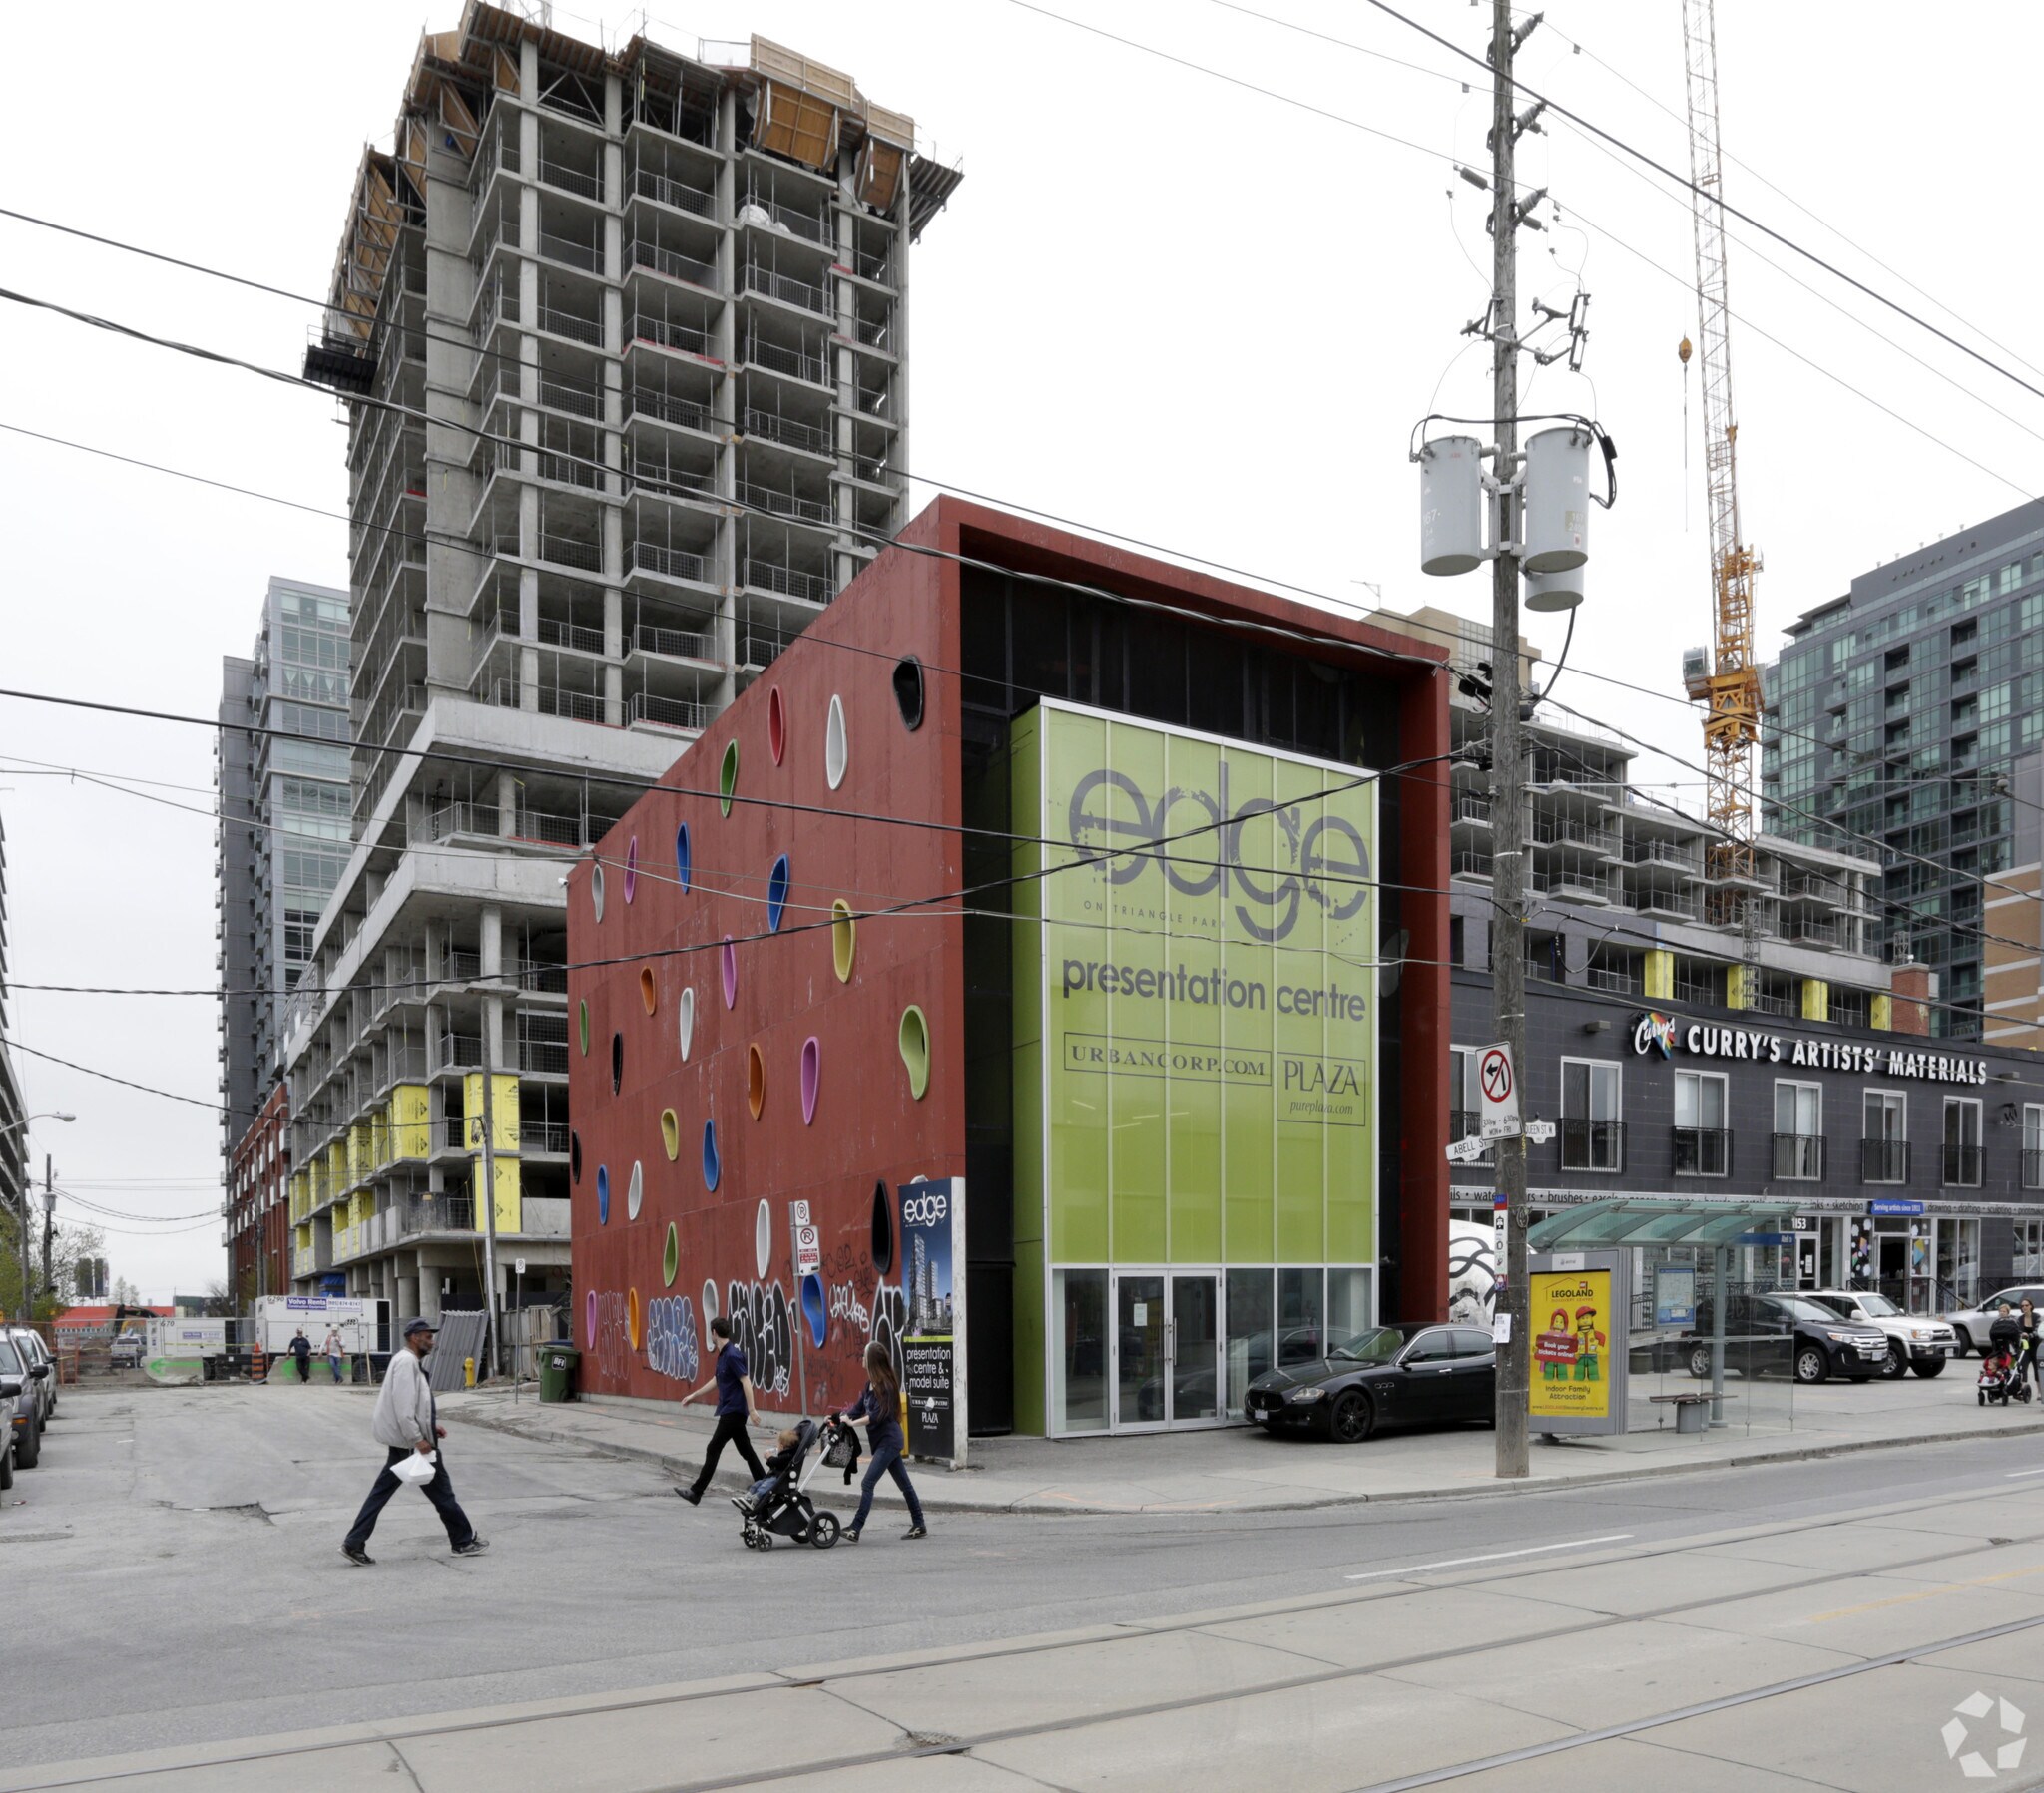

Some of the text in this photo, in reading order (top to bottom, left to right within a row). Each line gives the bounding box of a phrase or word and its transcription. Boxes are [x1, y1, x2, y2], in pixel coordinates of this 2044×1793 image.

[1069, 761, 1370, 943] edge
[1084, 900, 1103, 911] ON
[1113, 904, 1183, 923] TRIANGLE
[1063, 959, 1366, 1022] presentation centre
[1072, 1045, 1265, 1077] URBANCORP.COM
[1688, 1025, 1988, 1085] CURRY'S ARTISTS' MATERIALS
[1283, 1060, 1361, 1096] PLAZA
[1289, 1099, 1353, 1116] pureplaza.com
[1454, 1141, 1476, 1155] ABELL
[904, 1191, 947, 1227] edge
[1450, 1187, 1461, 1201] ils
[1548, 1191, 1583, 1203] brushes
[1833, 1199, 1863, 1212] sketching
[1928, 1202, 1951, 1214] drawing
[1958, 1203, 1981, 1214] drafting
[1551, 1289, 1594, 1298] LEGOLAND
[906, 1346, 951, 1362] presentation
[913, 1361, 937, 1374] centre
[909, 1375, 950, 1389] model suite
[1568, 1385, 1591, 1394] Family
[921, 1411, 939, 1424] PLAZA
